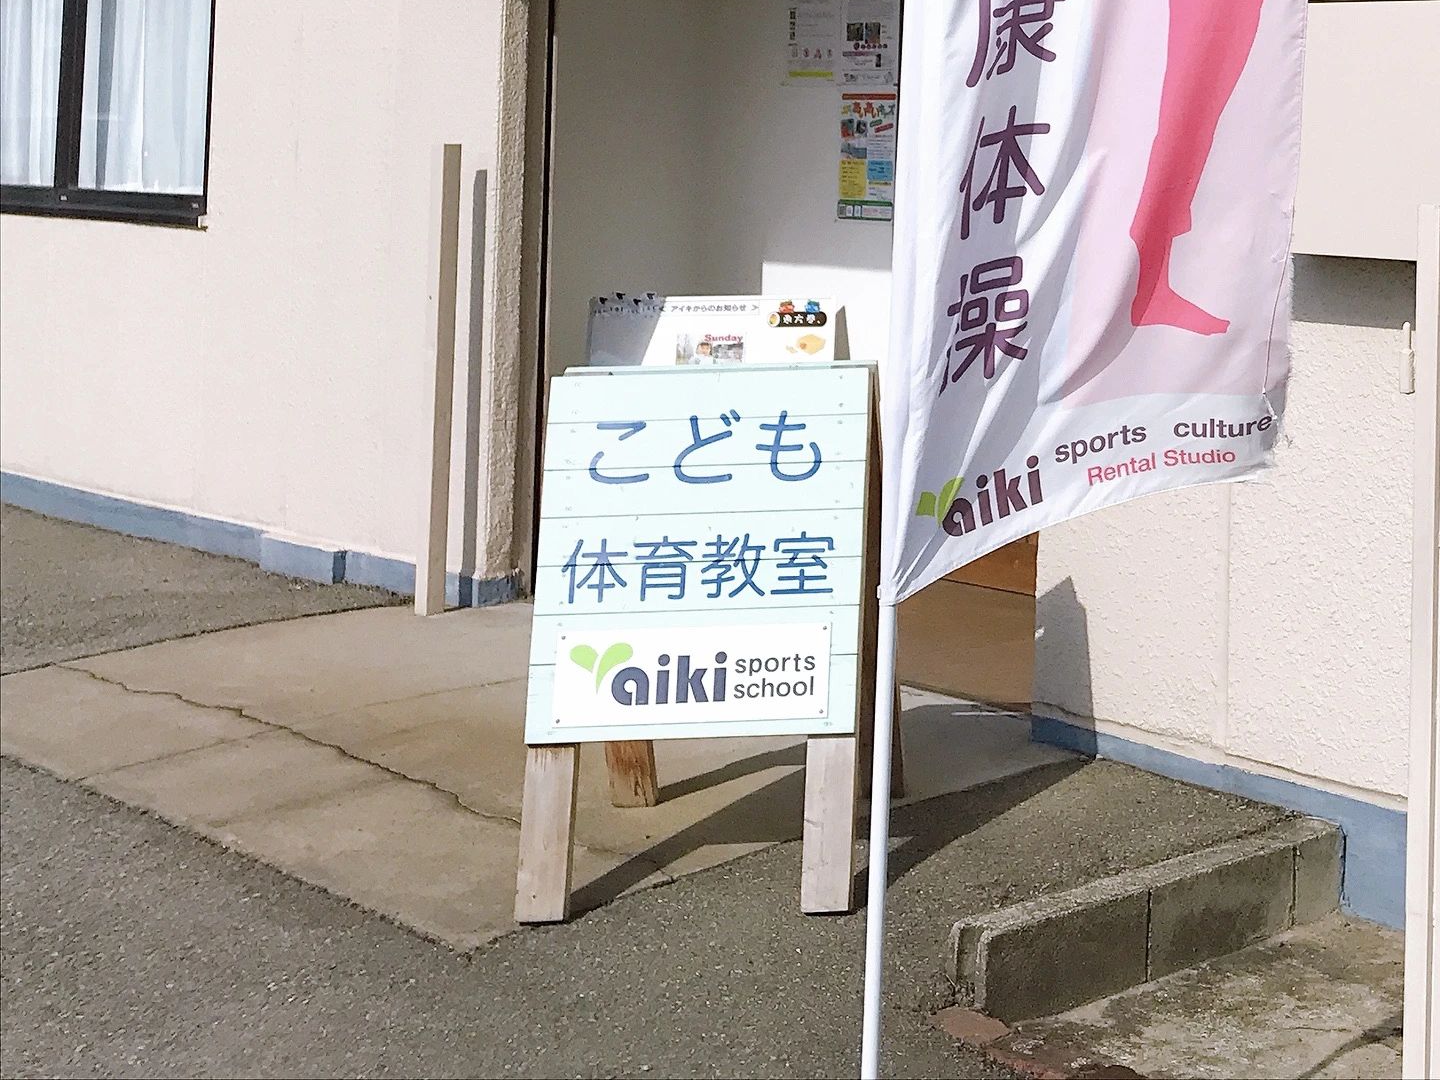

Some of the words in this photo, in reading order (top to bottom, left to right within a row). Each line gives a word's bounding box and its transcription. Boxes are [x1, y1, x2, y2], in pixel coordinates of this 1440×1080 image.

[704, 333, 744, 344] Sunday
[588, 409, 823, 484] こども
[1087, 452, 1157, 486] Rental
[1163, 449, 1237, 467] Studio
[942, 455, 1044, 537] aiki
[1054, 423, 1148, 463] sports
[1173, 413, 1273, 439] culture
[562, 531, 834, 604] 体育教室
[611, 651, 728, 706] aiki
[734, 651, 816, 678] sports
[733, 677, 814, 699] school
